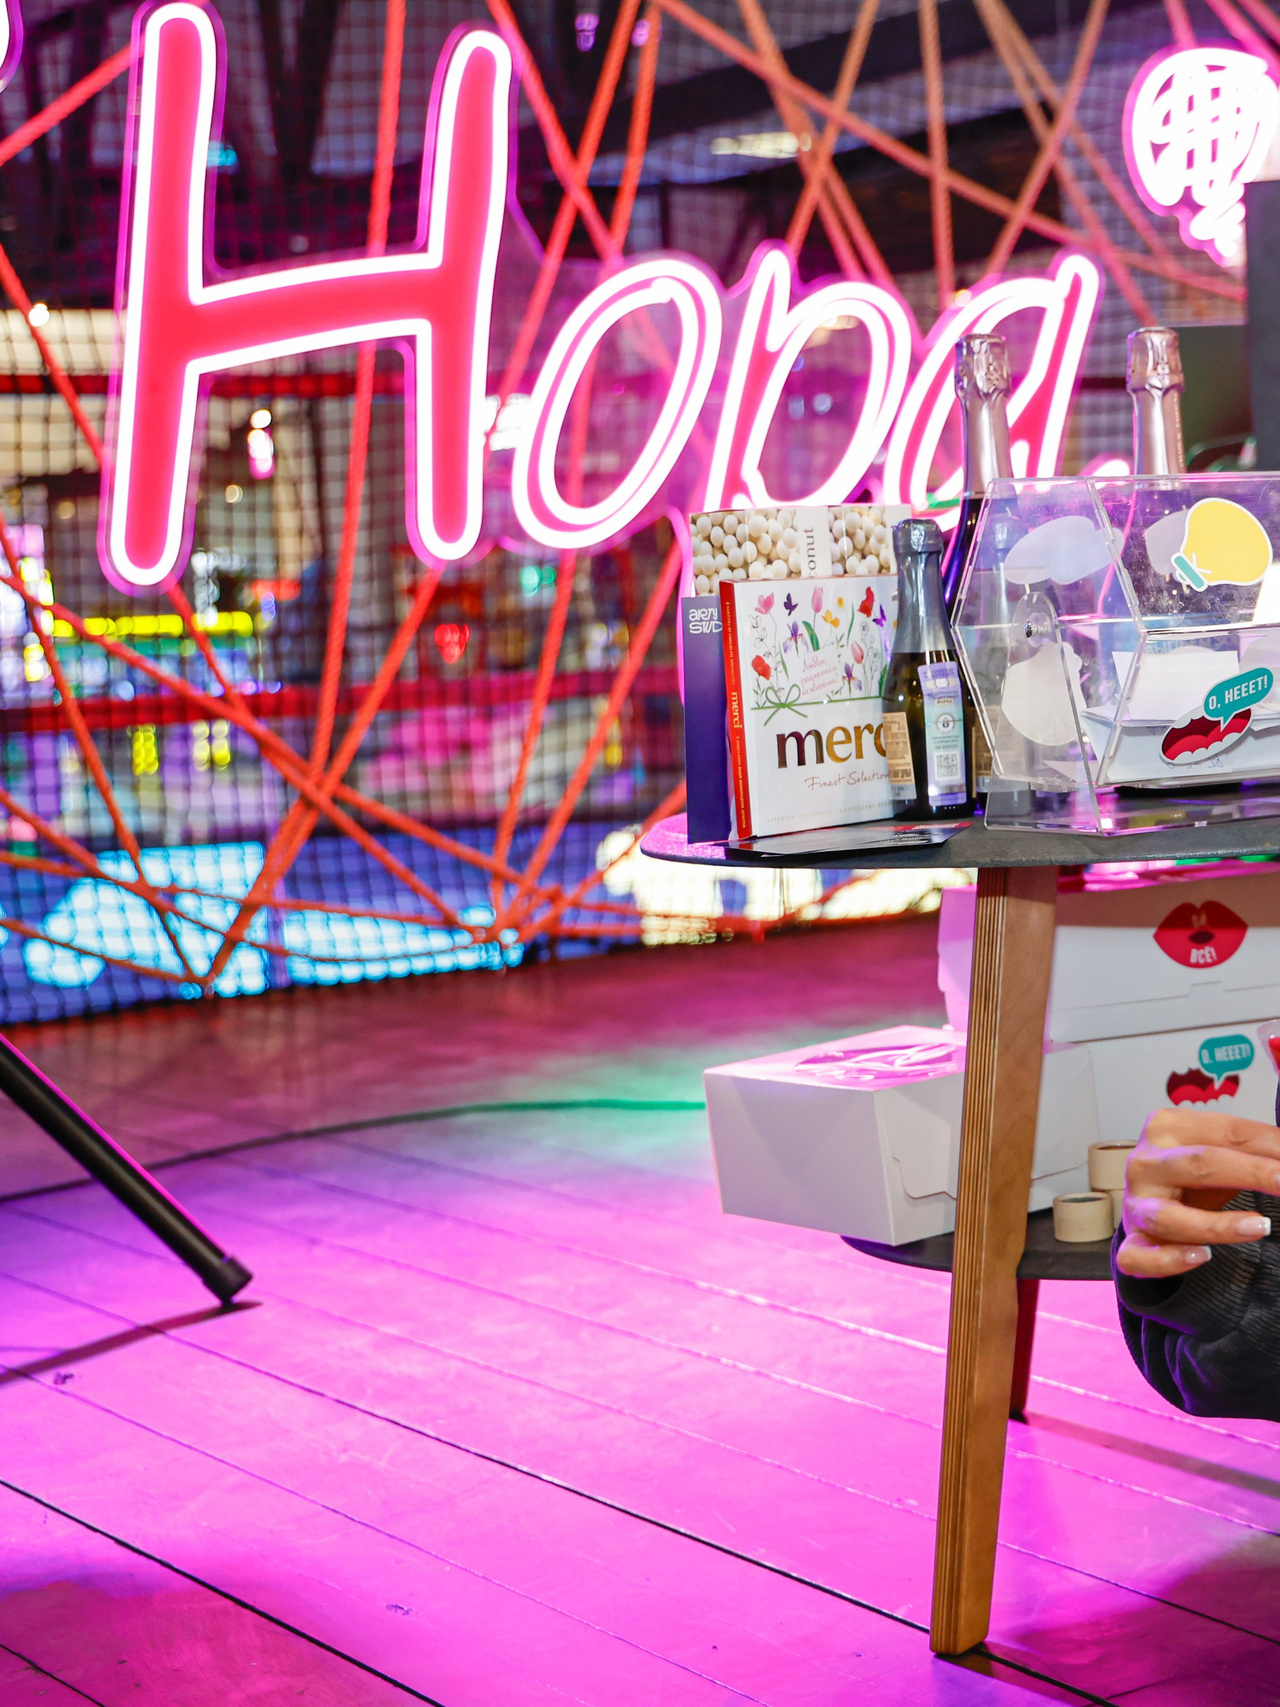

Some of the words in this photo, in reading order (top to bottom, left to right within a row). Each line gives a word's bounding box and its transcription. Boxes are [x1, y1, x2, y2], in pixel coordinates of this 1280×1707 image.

[731, 691, 743, 729] merci
[1208, 695, 1221, 710] О,
[1224, 674, 1268, 705] НЕЕЕТ!
[804, 775, 847, 791] Finest
